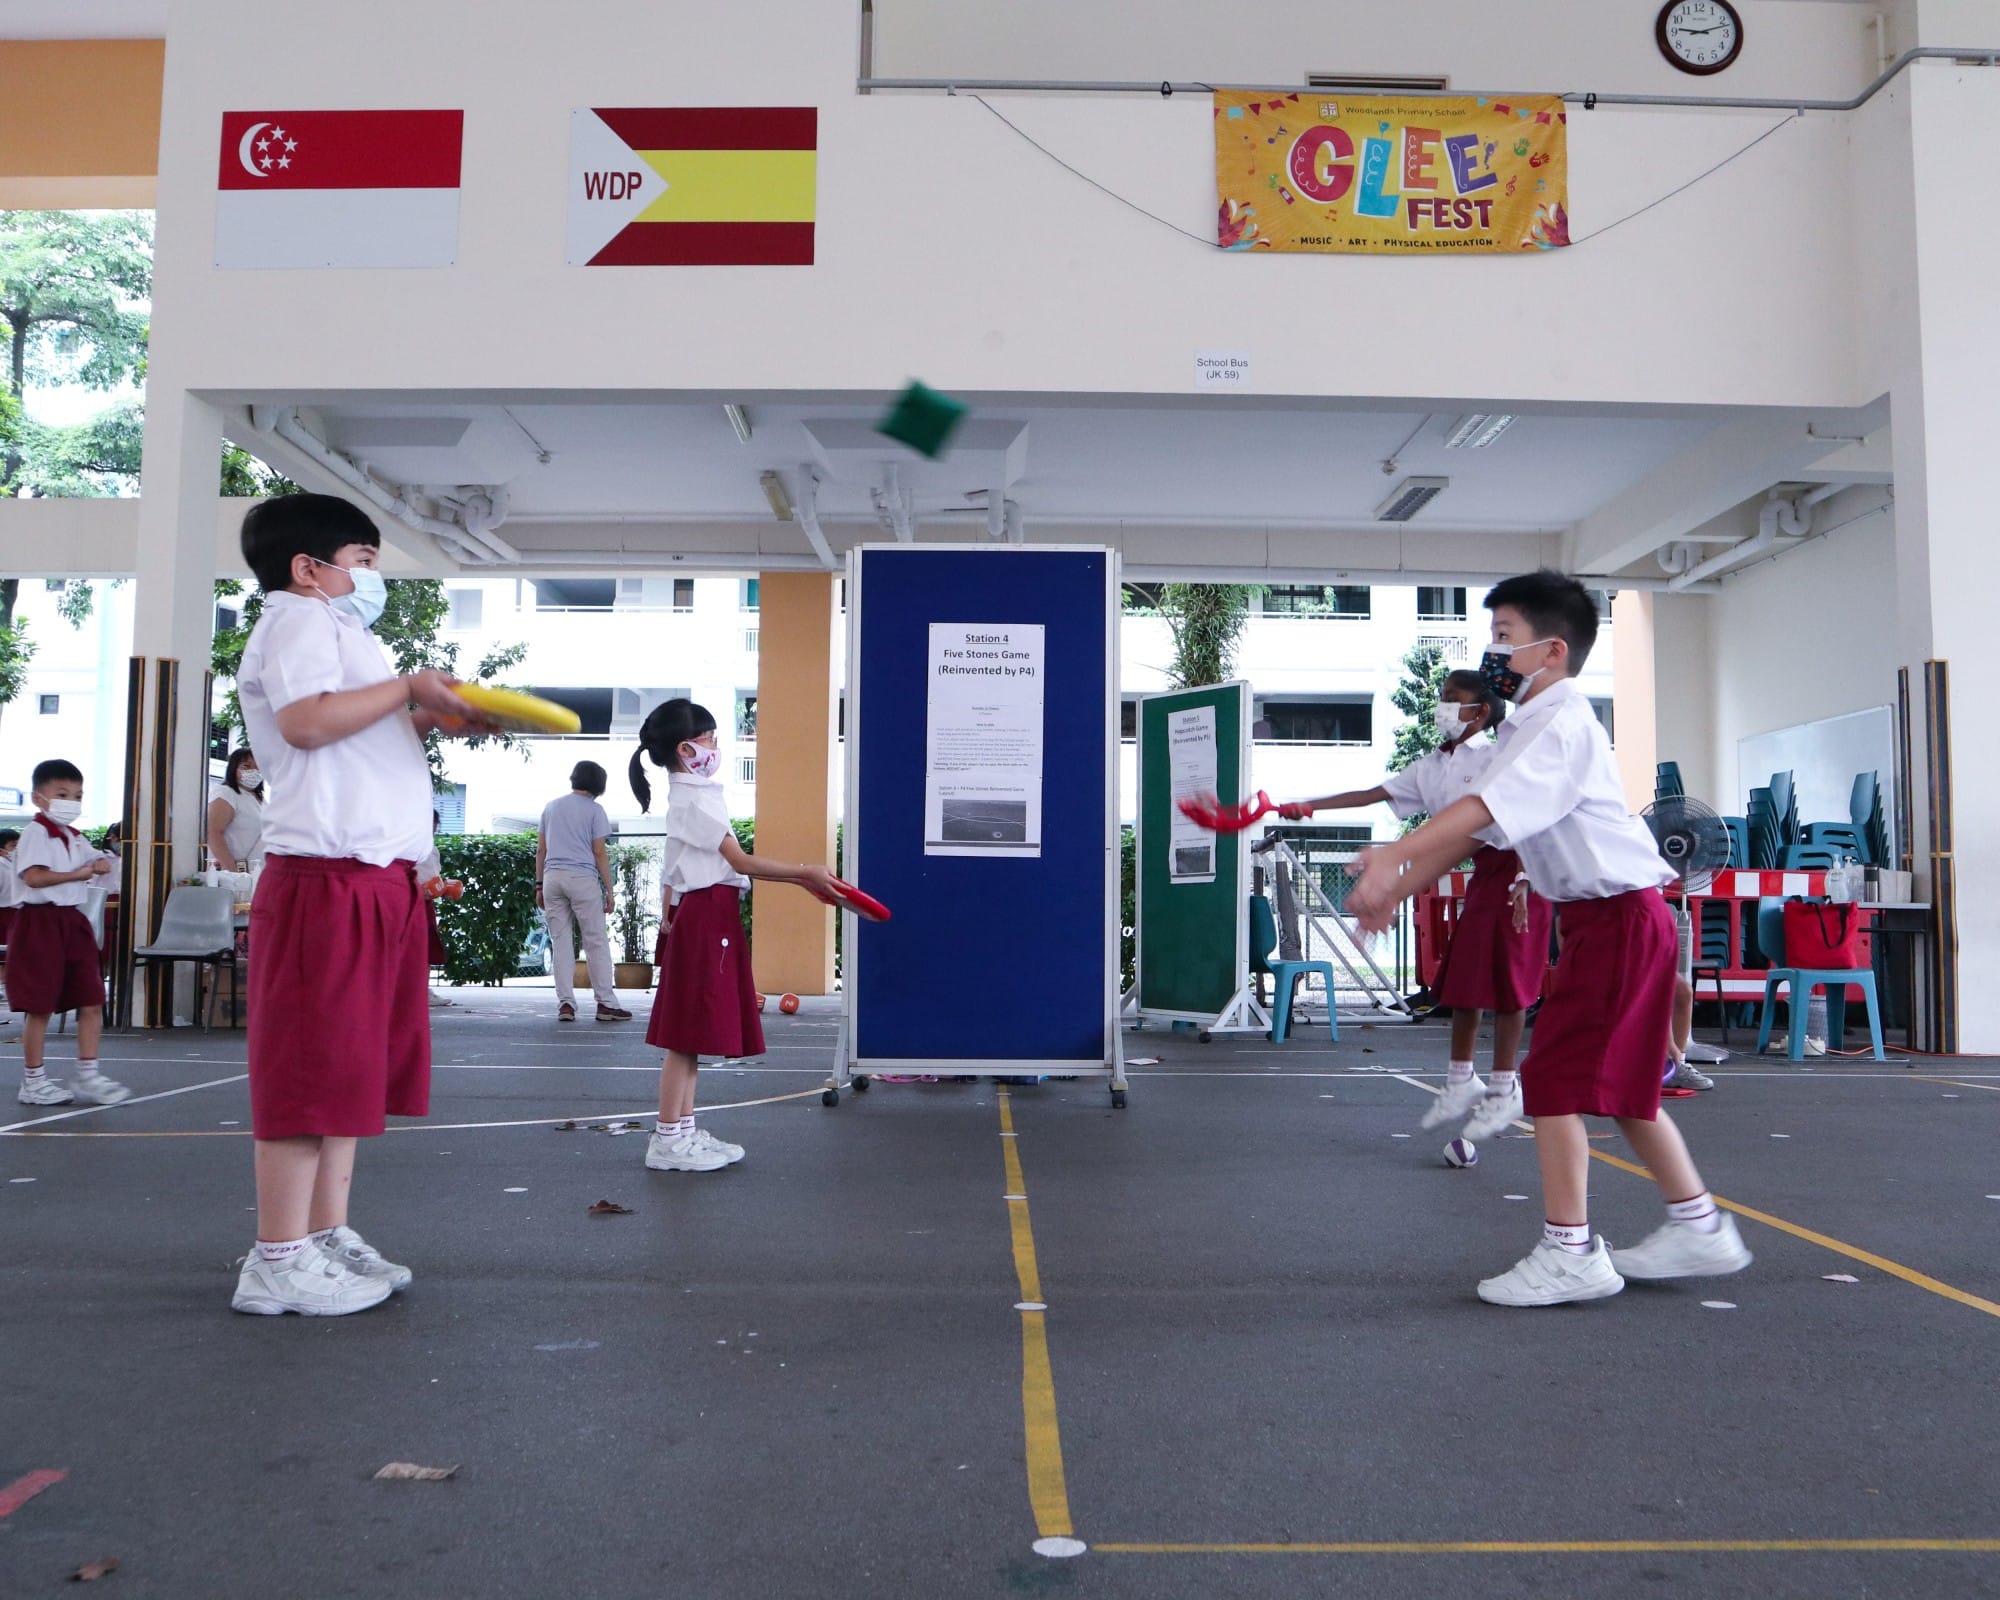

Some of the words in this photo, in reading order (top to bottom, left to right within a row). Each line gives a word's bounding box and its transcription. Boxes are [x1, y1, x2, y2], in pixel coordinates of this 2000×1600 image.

[1682, 6, 1691, 15] 11
[1694, 2, 1705, 13] 12
[1710, 6, 1716, 16] 1
[1673, 15, 1683, 24] 10
[1719, 15, 1726, 25] 2
[1671, 27, 1678, 37] 9
[1722, 29, 1729, 38] 3
[1675, 40, 1682, 49] 8
[1718, 41, 1725, 50] 4
[1684, 49, 1691, 58] 7
[1697, 52, 1704, 62] 6
[1711, 50, 1718, 59] 5
[1344, 106, 1395, 116] Woodlands
[1398, 107, 1432, 117] Primary
[1435, 108, 1467, 117] School
[584, 171, 643, 200] WDP
[1407, 197, 1494, 231] FEST
[1300, 236, 1333, 245] MUSIC
[1348, 238, 1368, 246] ART
[1384, 238, 1432, 248] PHYSICAL
[1435, 238, 1493, 248] EDUCATION
[1197, 358, 1228, 367] School
[1230, 358, 1249, 367] Bus
[1206, 370, 1222, 380] (JK
[1224, 370, 1240, 380] 59)
[965, 634, 1000, 643] Station
[1003, 634, 1009, 643] 4
[944, 649, 964, 658] Five
[966, 649, 999, 658] Stones
[1001, 650, 1030, 660] Game
[938, 664, 1002, 676] (Reinvented
[1005, 666, 1016, 677] by
[1020, 666, 1035, 677] P4)
